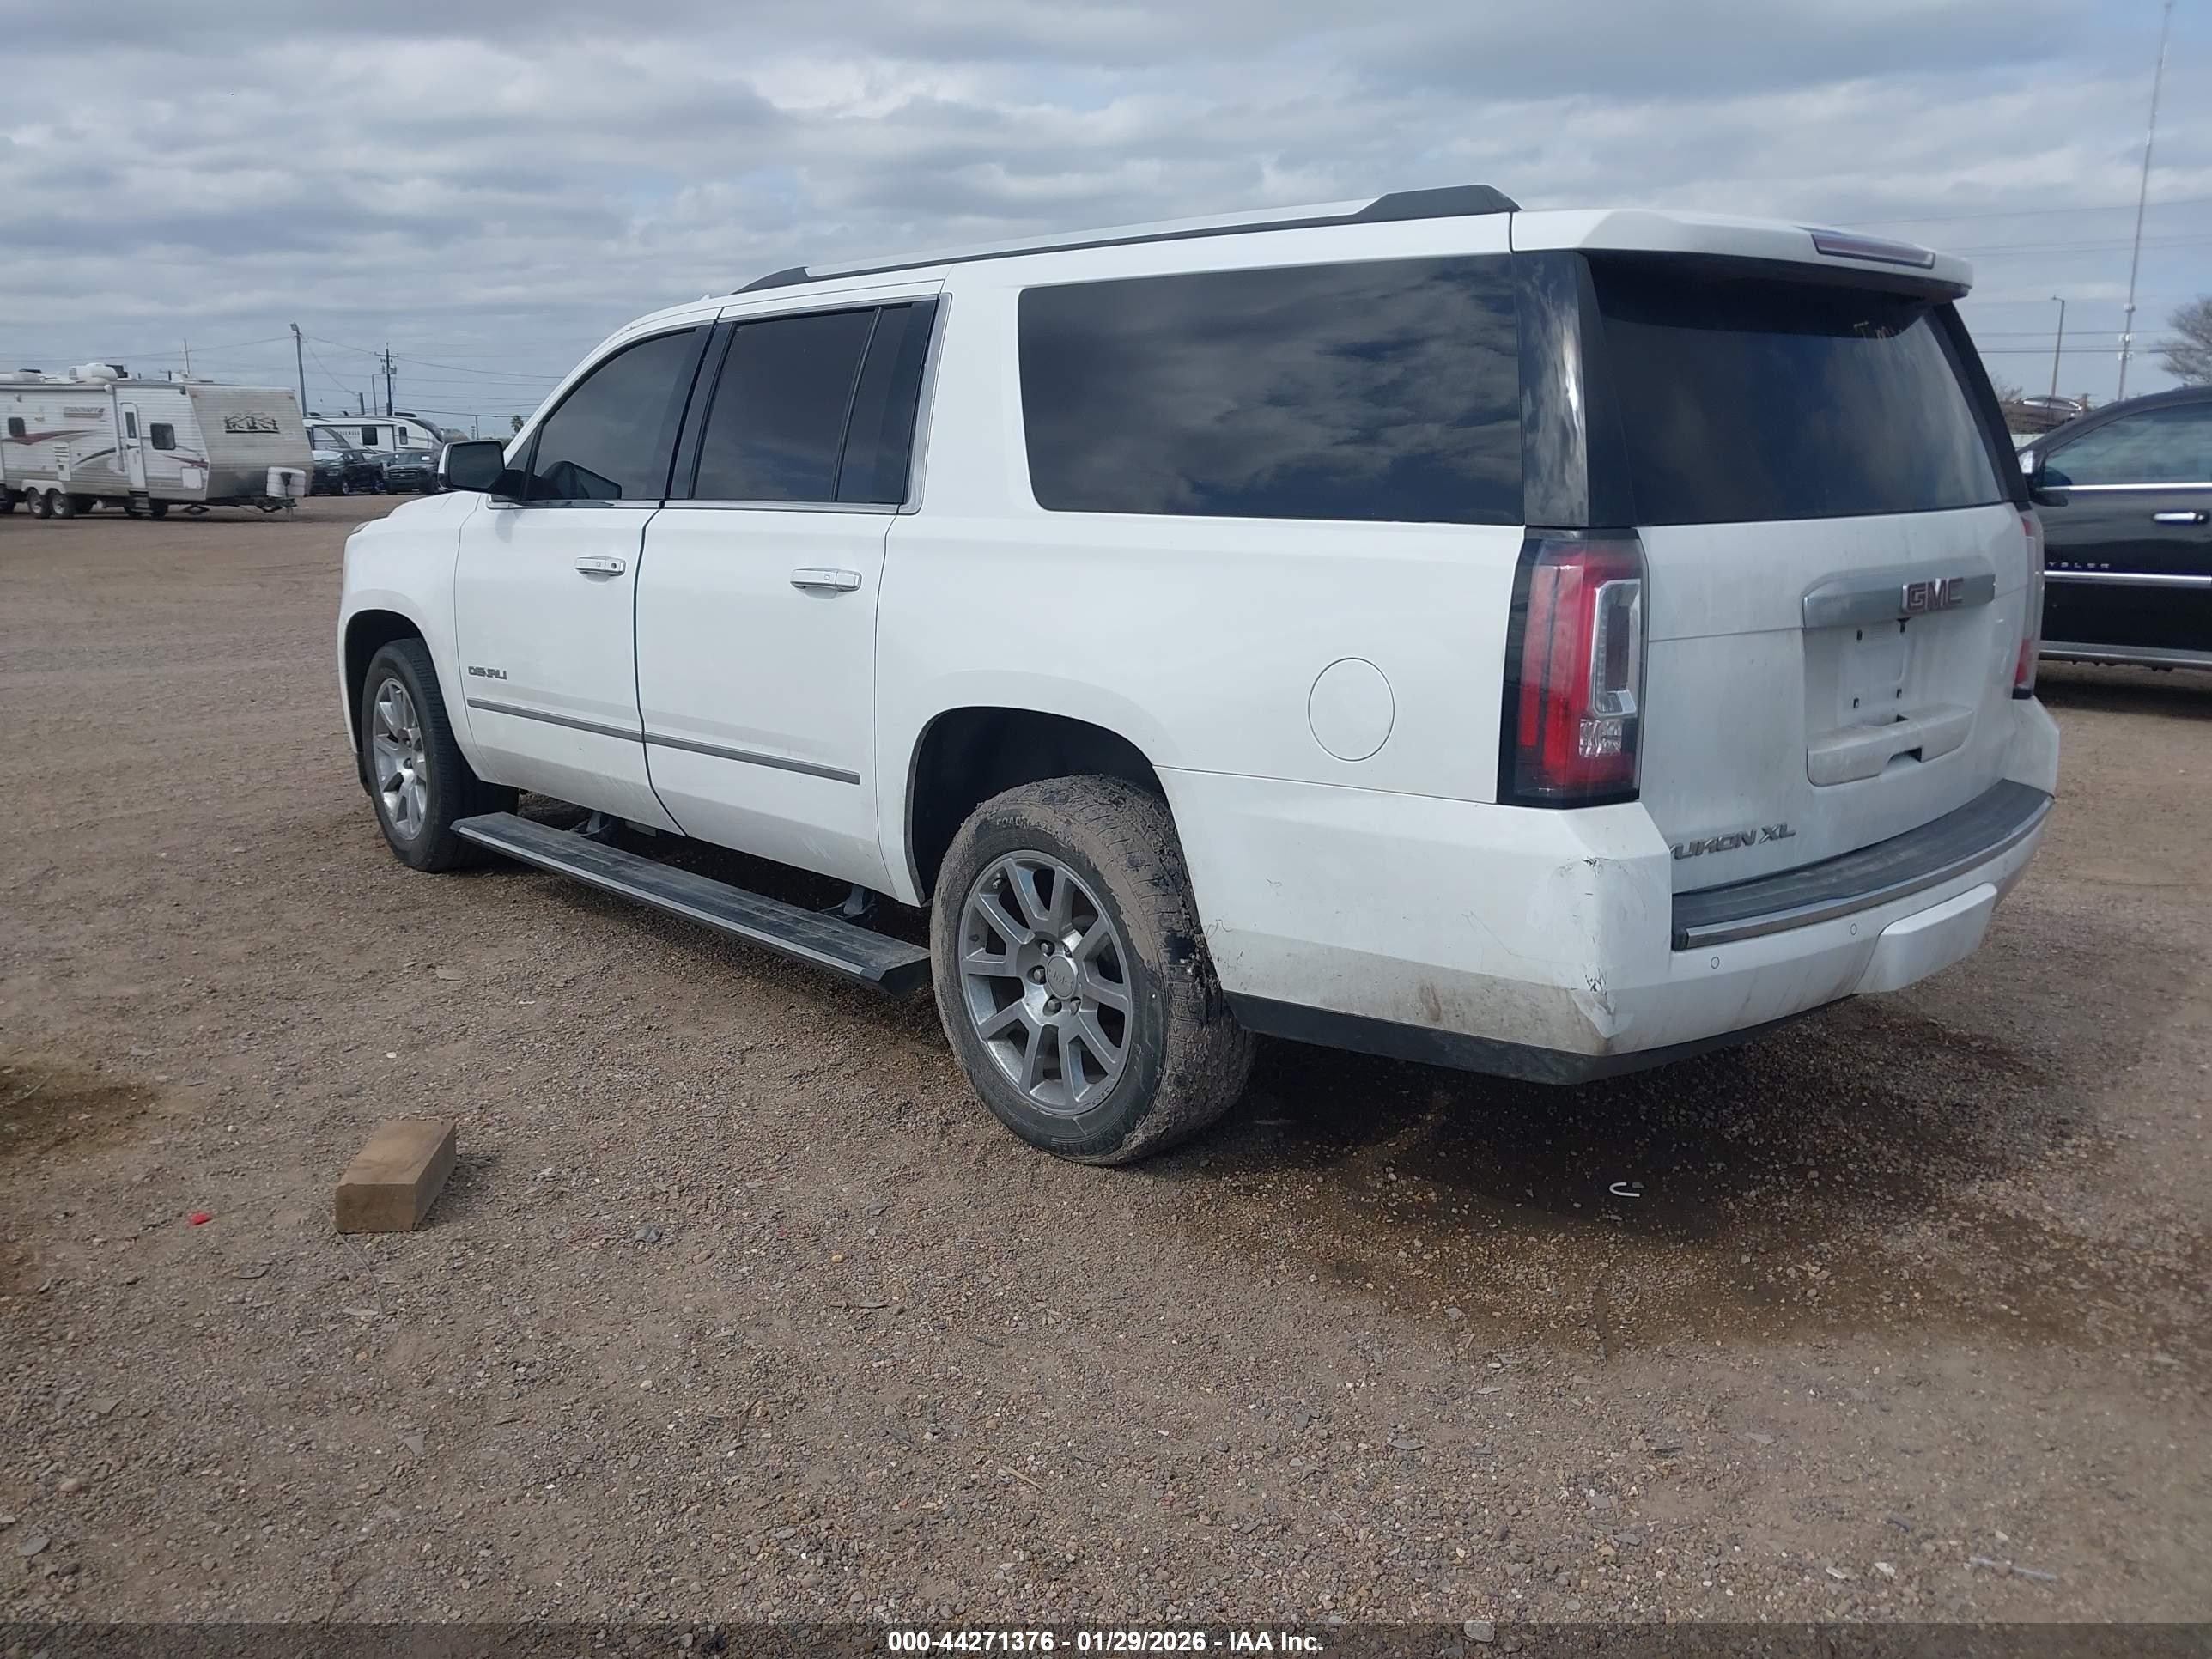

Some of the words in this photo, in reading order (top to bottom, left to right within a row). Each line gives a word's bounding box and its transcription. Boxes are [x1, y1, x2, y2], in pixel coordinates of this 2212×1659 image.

[1903, 577, 1964, 611] GMC
[468, 666, 507, 680] DENALI
[1759, 823, 1797, 845] XL
